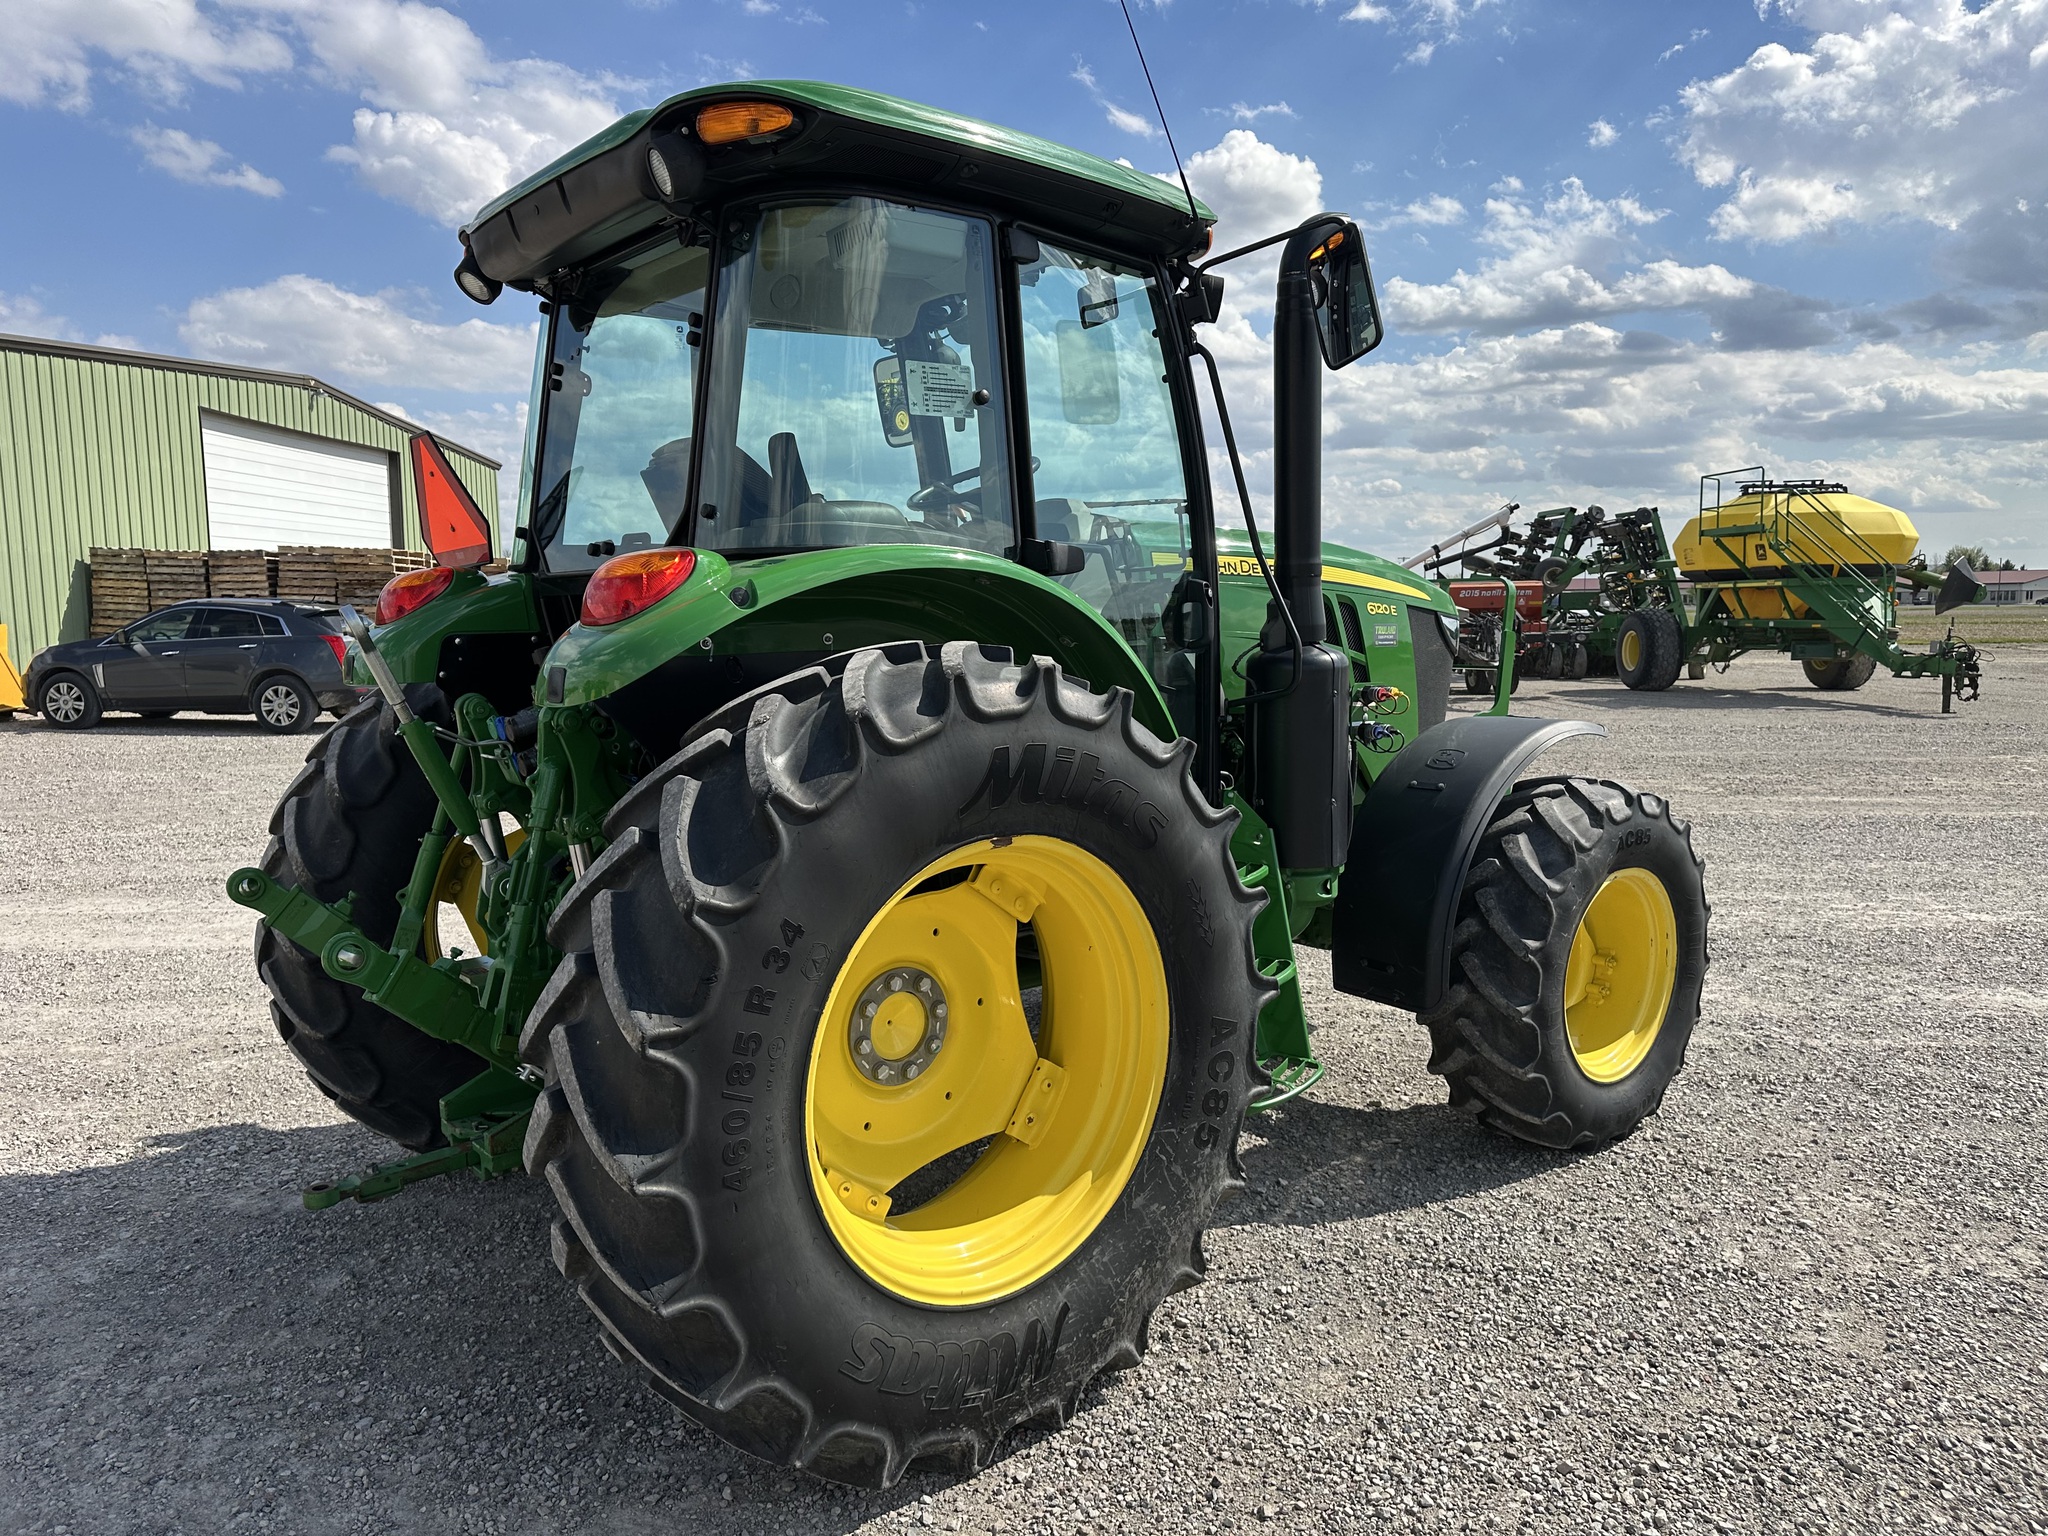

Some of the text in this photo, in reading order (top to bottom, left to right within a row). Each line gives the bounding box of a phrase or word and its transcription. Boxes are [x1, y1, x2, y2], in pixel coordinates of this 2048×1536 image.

[1218, 561, 1238, 573] HN
[1459, 589, 1480, 598] 2015
[1366, 602, 1398, 616] 6120 E
[958, 742, 1169, 850] Mitas
[1615, 827, 1651, 856] AC85
[721, 916, 806, 1192] 460/85 R 34
[1193, 1016, 1239, 1151] AC85
[838, 1301, 1071, 1411] Mitas
